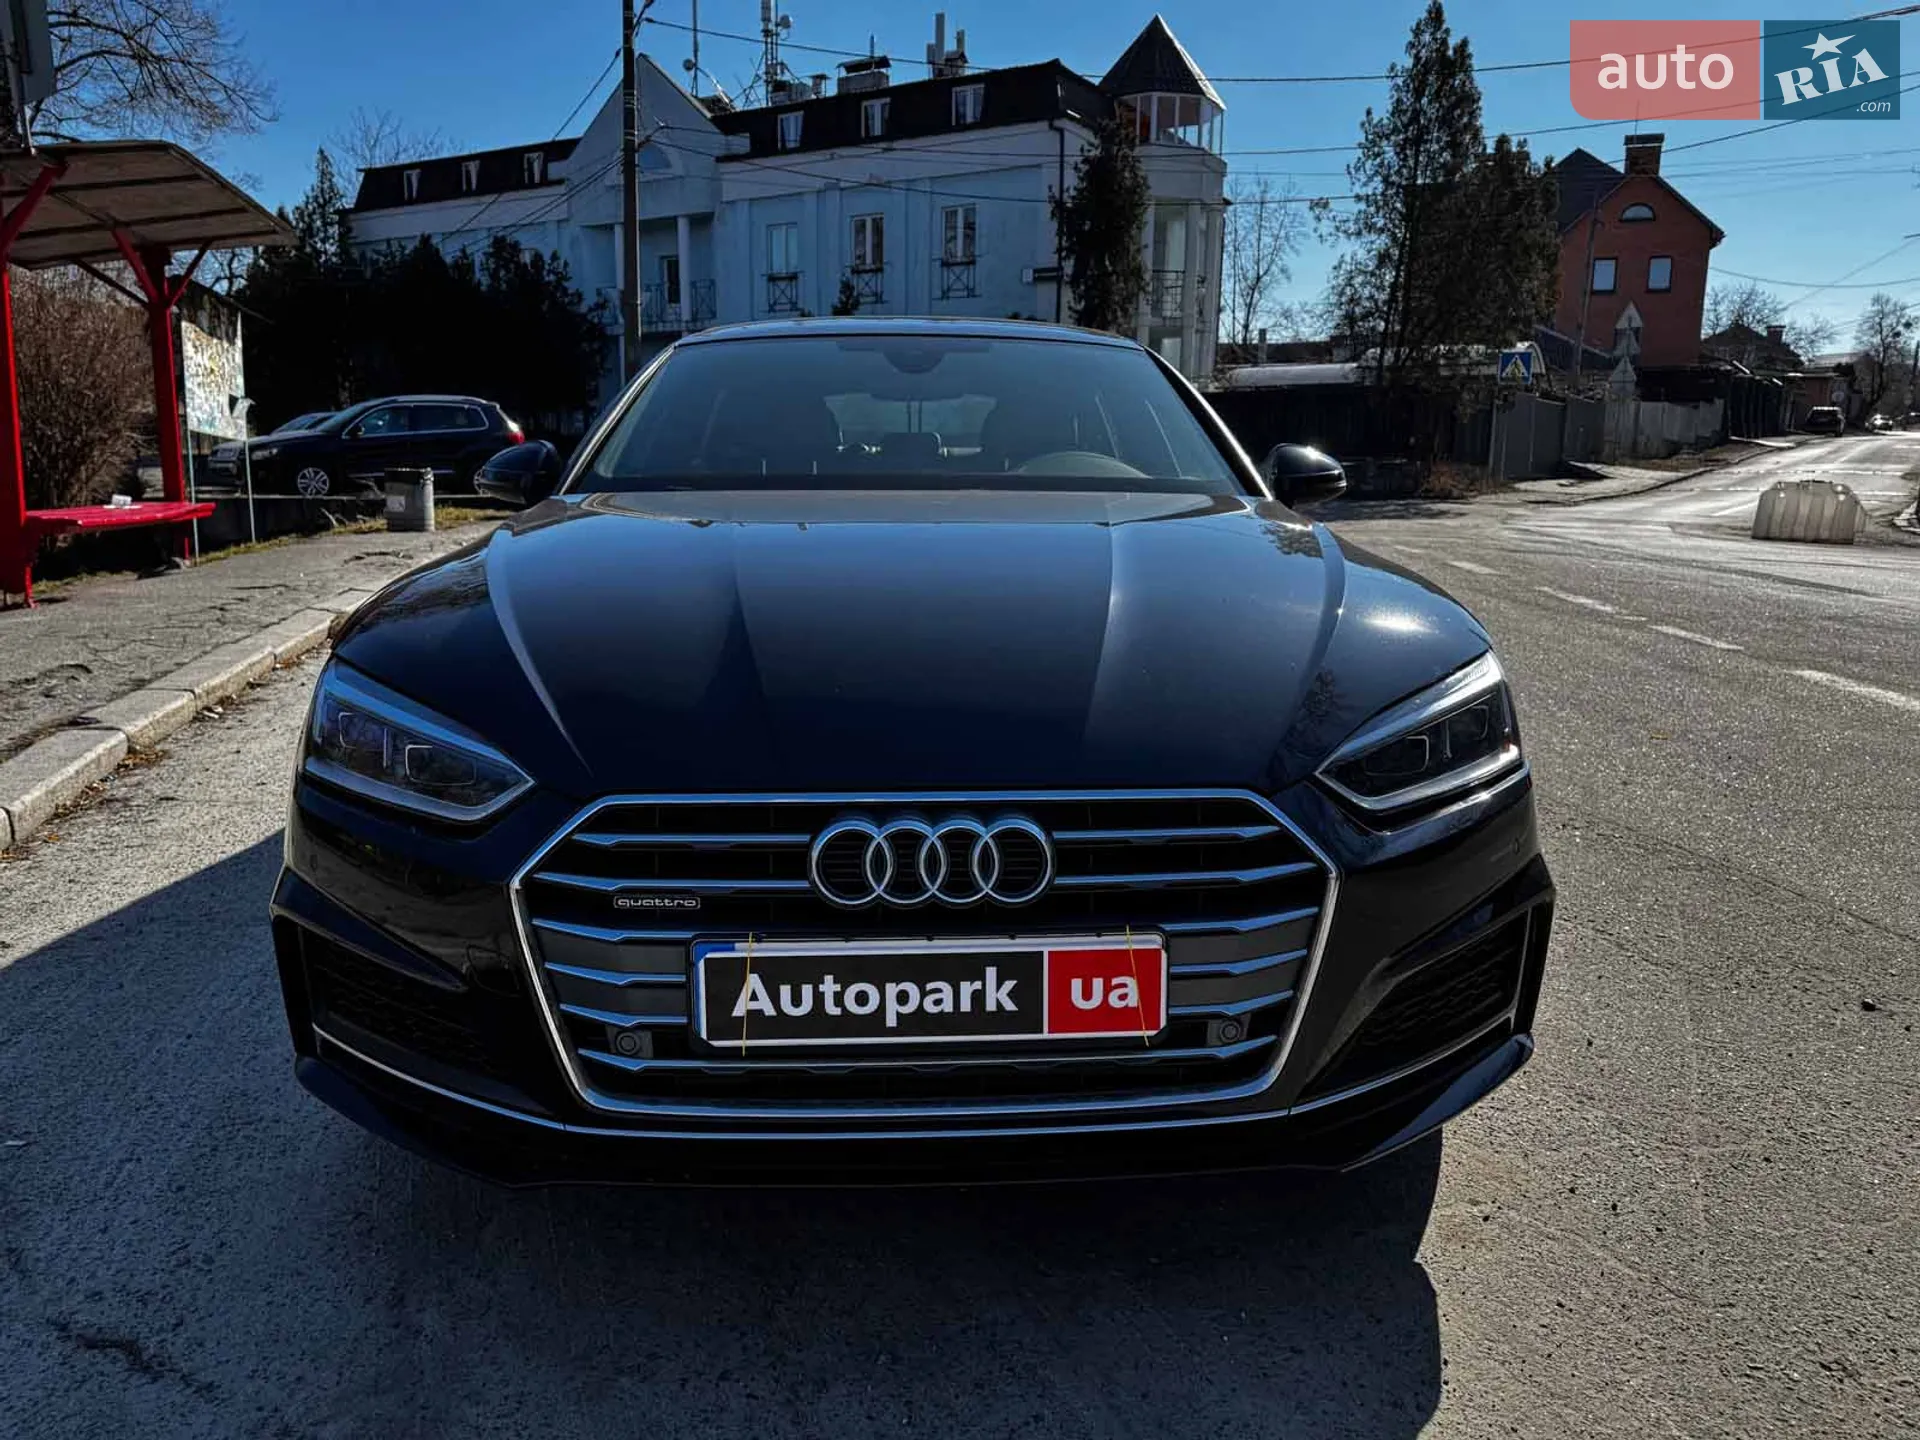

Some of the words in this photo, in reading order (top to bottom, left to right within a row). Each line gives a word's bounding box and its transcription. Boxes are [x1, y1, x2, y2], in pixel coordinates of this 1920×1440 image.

[617, 898, 697, 908] quattro
[731, 966, 1019, 1028] Autopark
[1070, 974, 1139, 1010] ua
